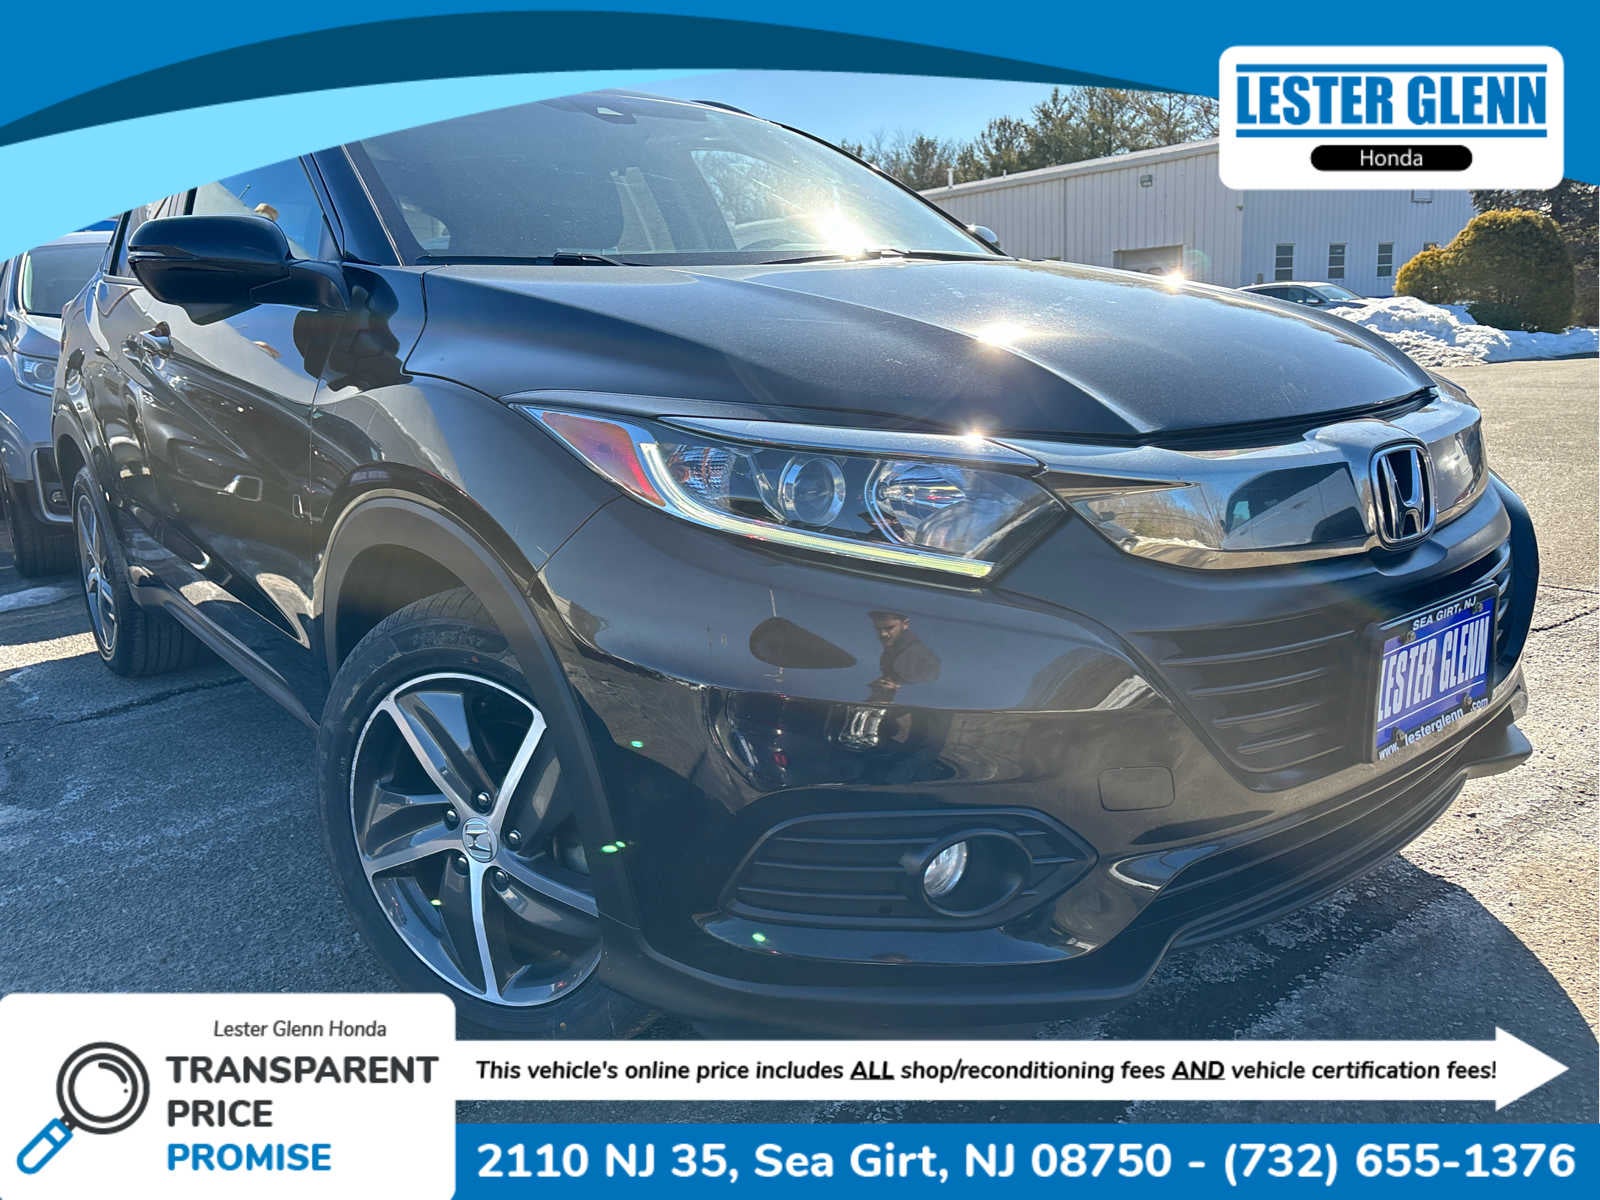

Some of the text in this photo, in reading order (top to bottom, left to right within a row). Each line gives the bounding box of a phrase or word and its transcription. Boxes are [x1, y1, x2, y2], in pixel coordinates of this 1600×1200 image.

[1413, 597, 1476, 631] SEA GIRT, NJ
[1377, 616, 1490, 722] LESTER GLENN
